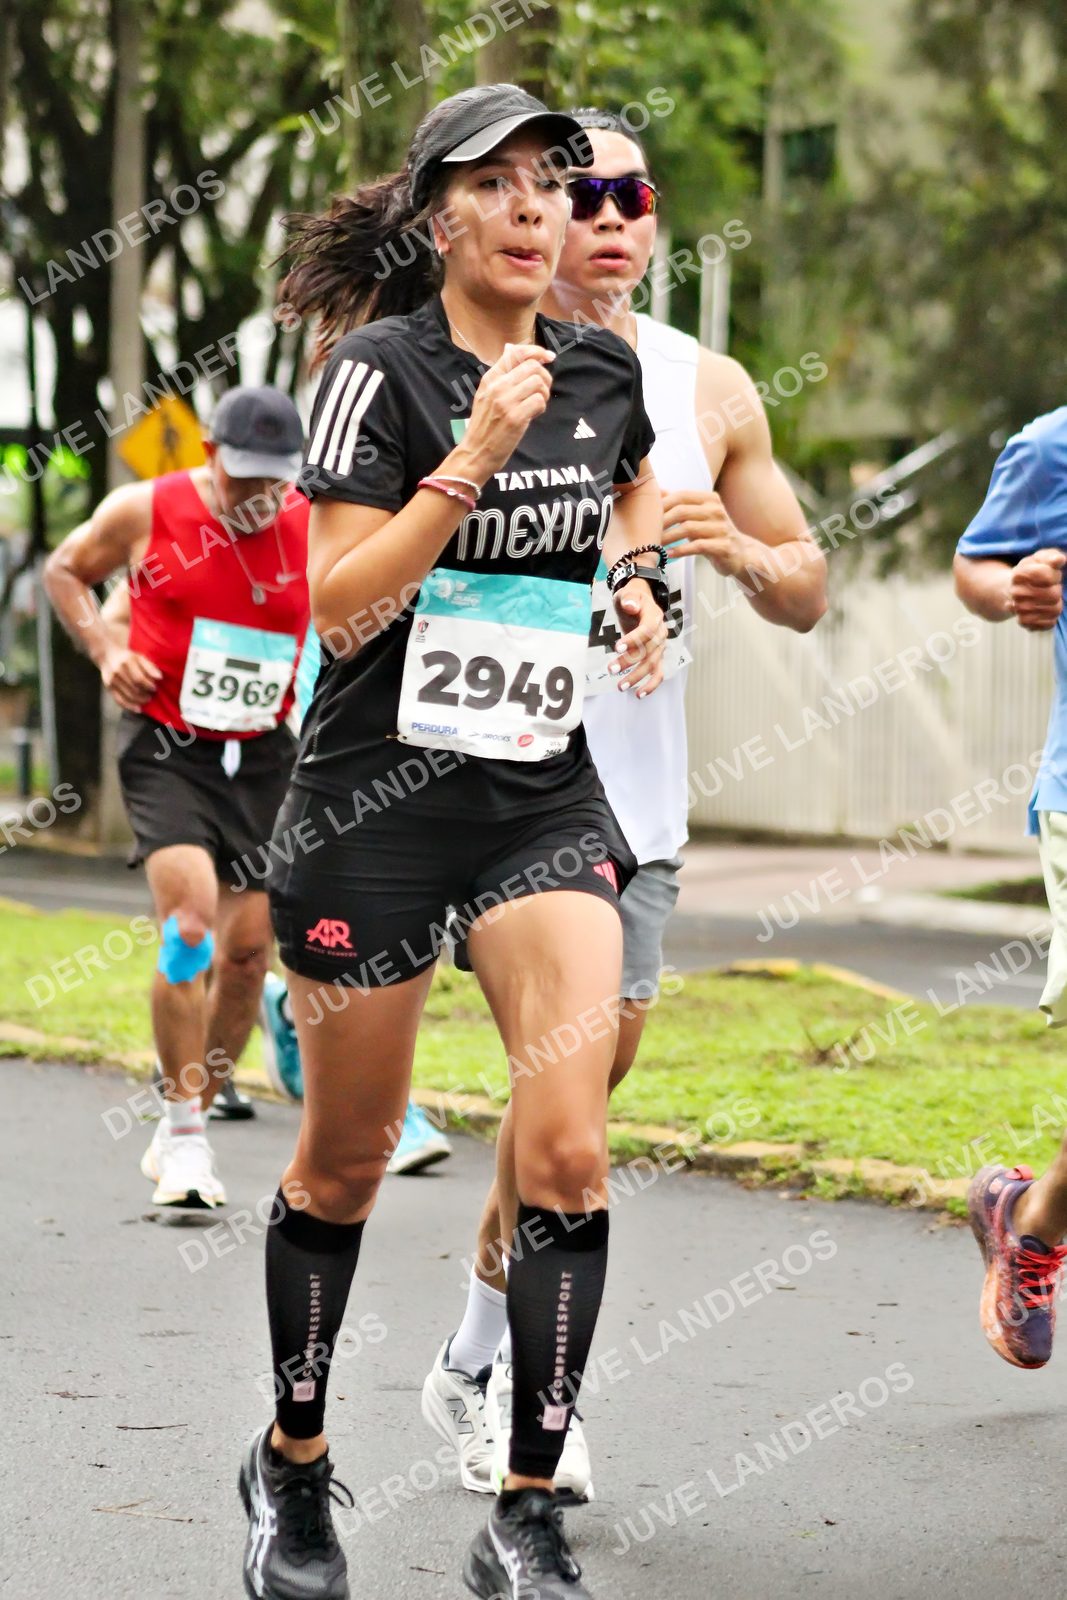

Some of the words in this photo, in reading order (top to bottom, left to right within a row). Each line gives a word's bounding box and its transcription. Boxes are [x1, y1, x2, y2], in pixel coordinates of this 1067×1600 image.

[494, 464, 594, 491] TATYANA
[192, 669, 280, 707] 3969
[417, 650, 574, 720] 2949
[411, 721, 458, 736] PERDURA
[552, 1271, 573, 1401] COMPRESSPORT
